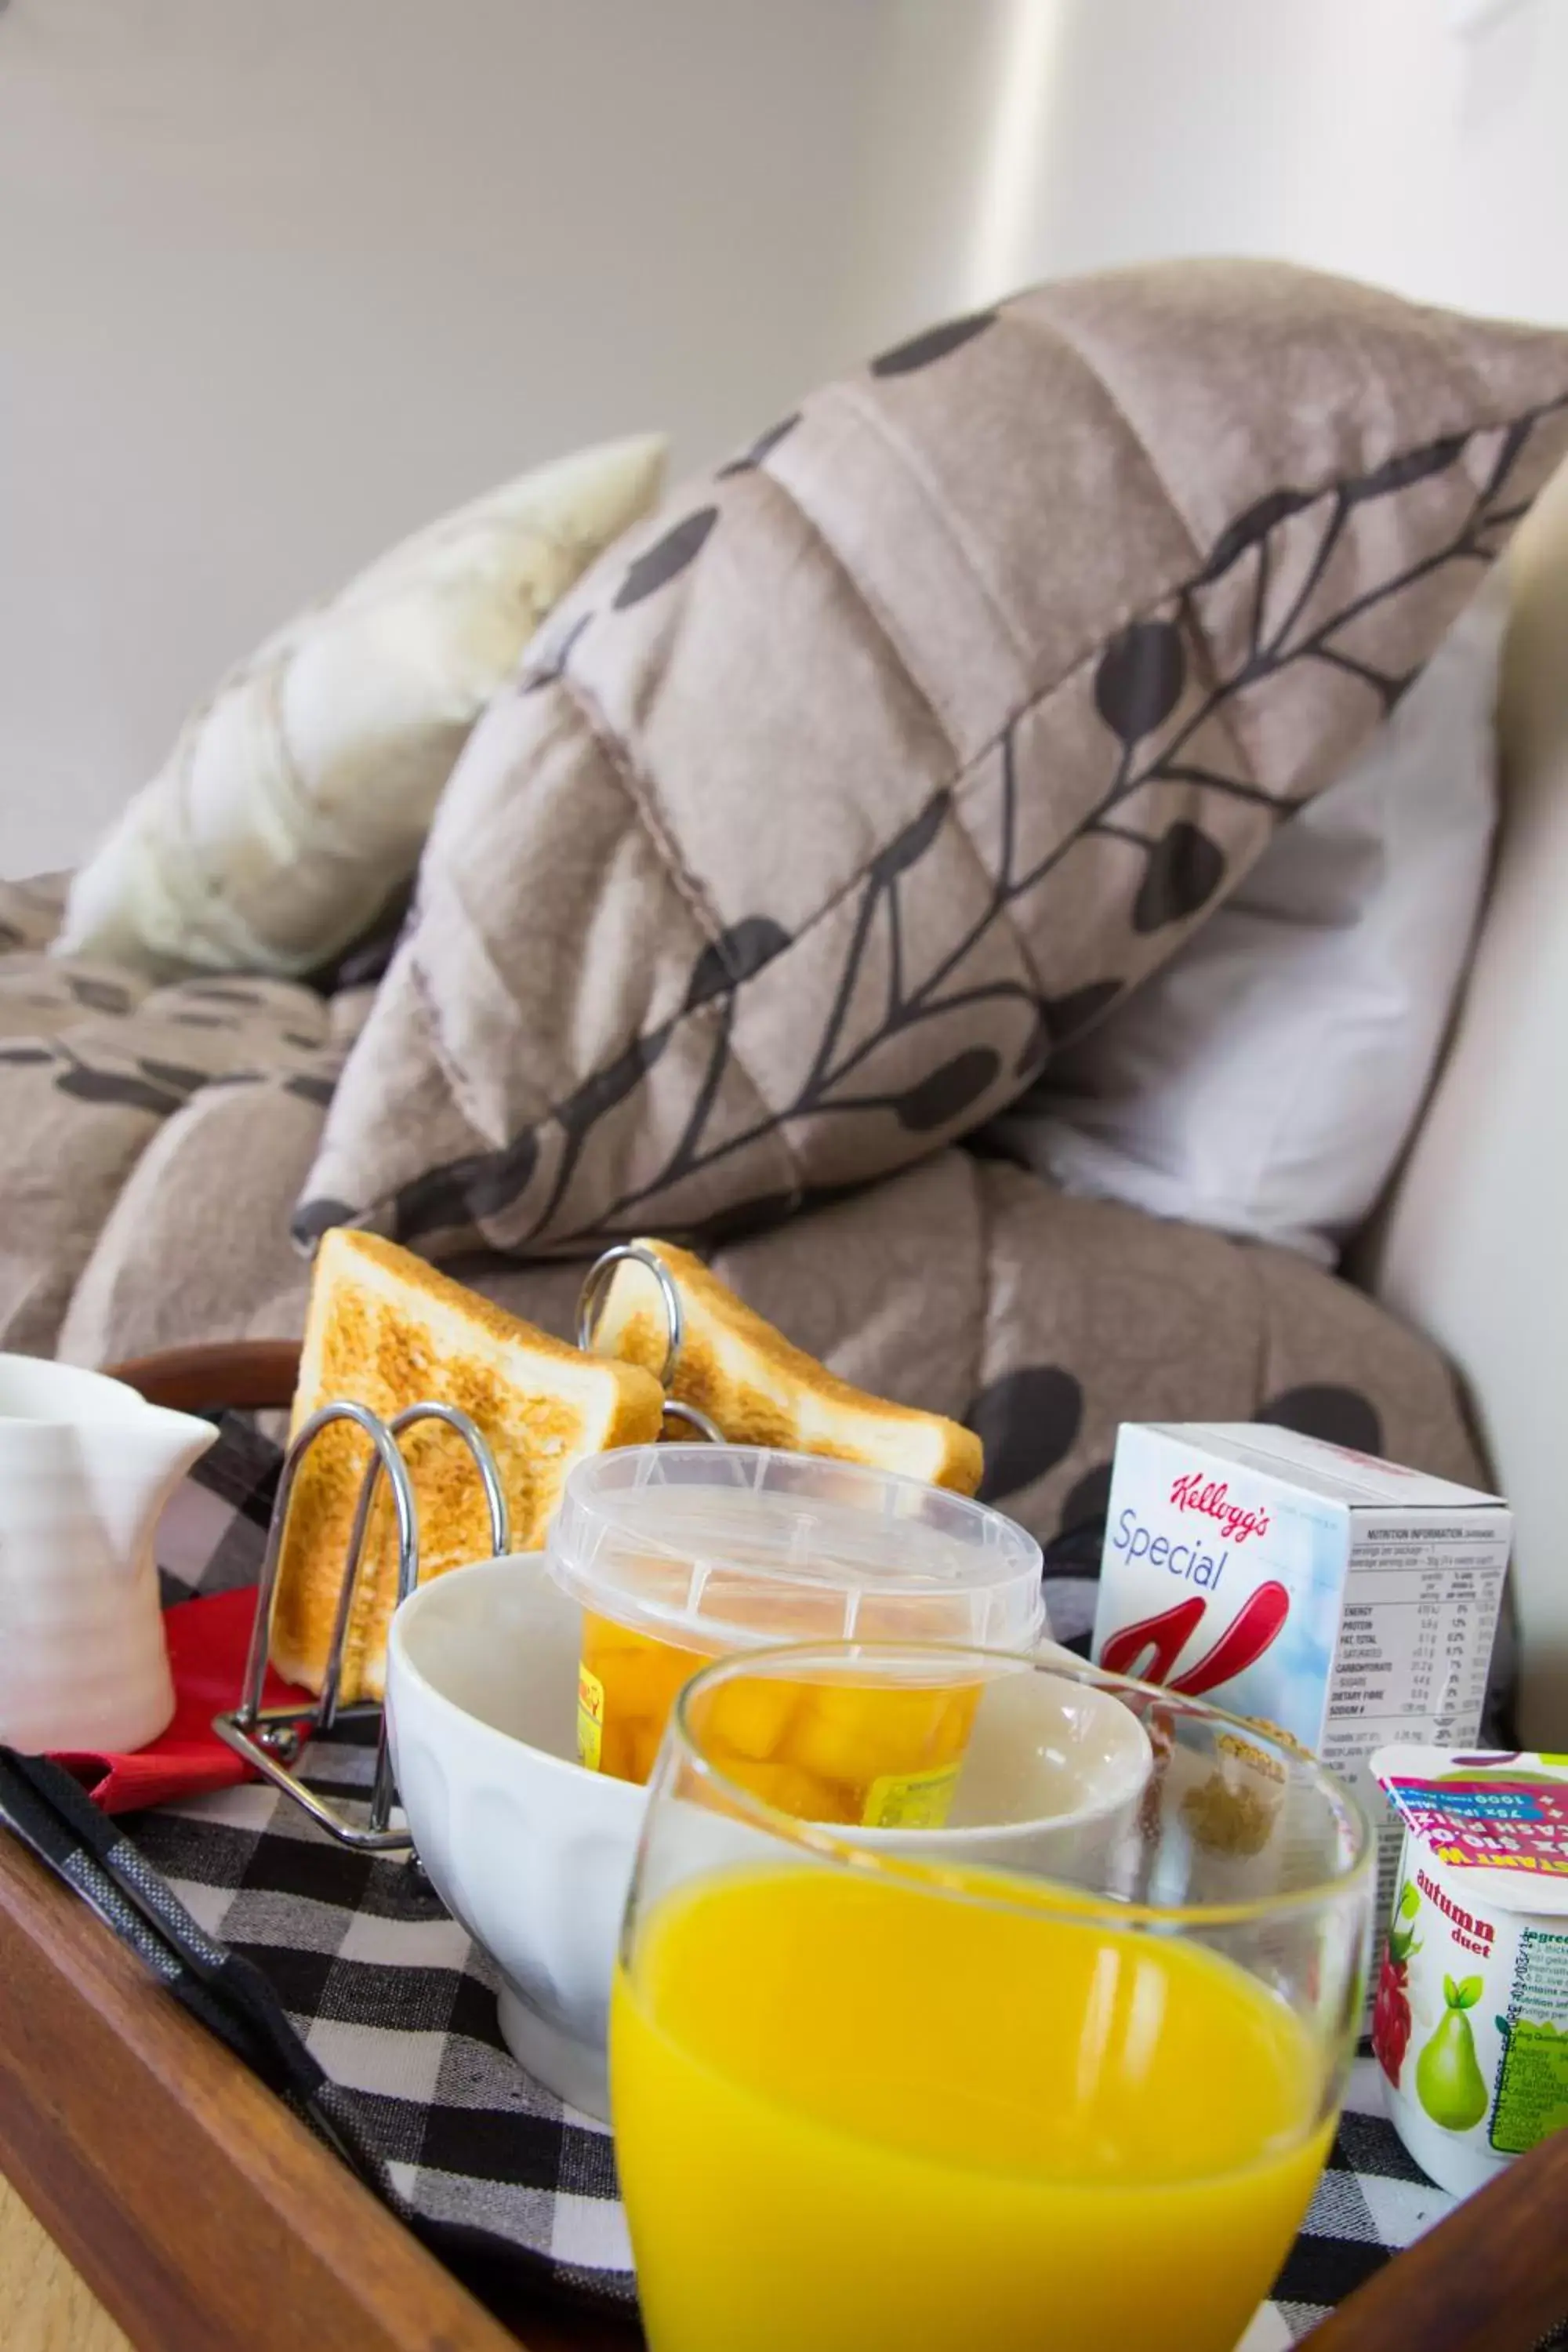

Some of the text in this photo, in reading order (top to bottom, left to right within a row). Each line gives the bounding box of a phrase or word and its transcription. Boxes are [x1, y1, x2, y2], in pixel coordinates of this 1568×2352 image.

[1171, 1472, 1270, 1543] Kellogg's
[1367, 1530, 1408, 1540] NUTRITION
[1410, 1529, 1463, 1539] INFORMATION
[1113, 1508, 1229, 1590] Special
[1345, 1607, 1373, 1617] ENERGY
[1342, 1621, 1373, 1631] PROTEIN
[1474, 1794, 1525, 1805] 1000
[1417, 1868, 1494, 1943] autumn
[1451, 1929, 1490, 1958] duet
